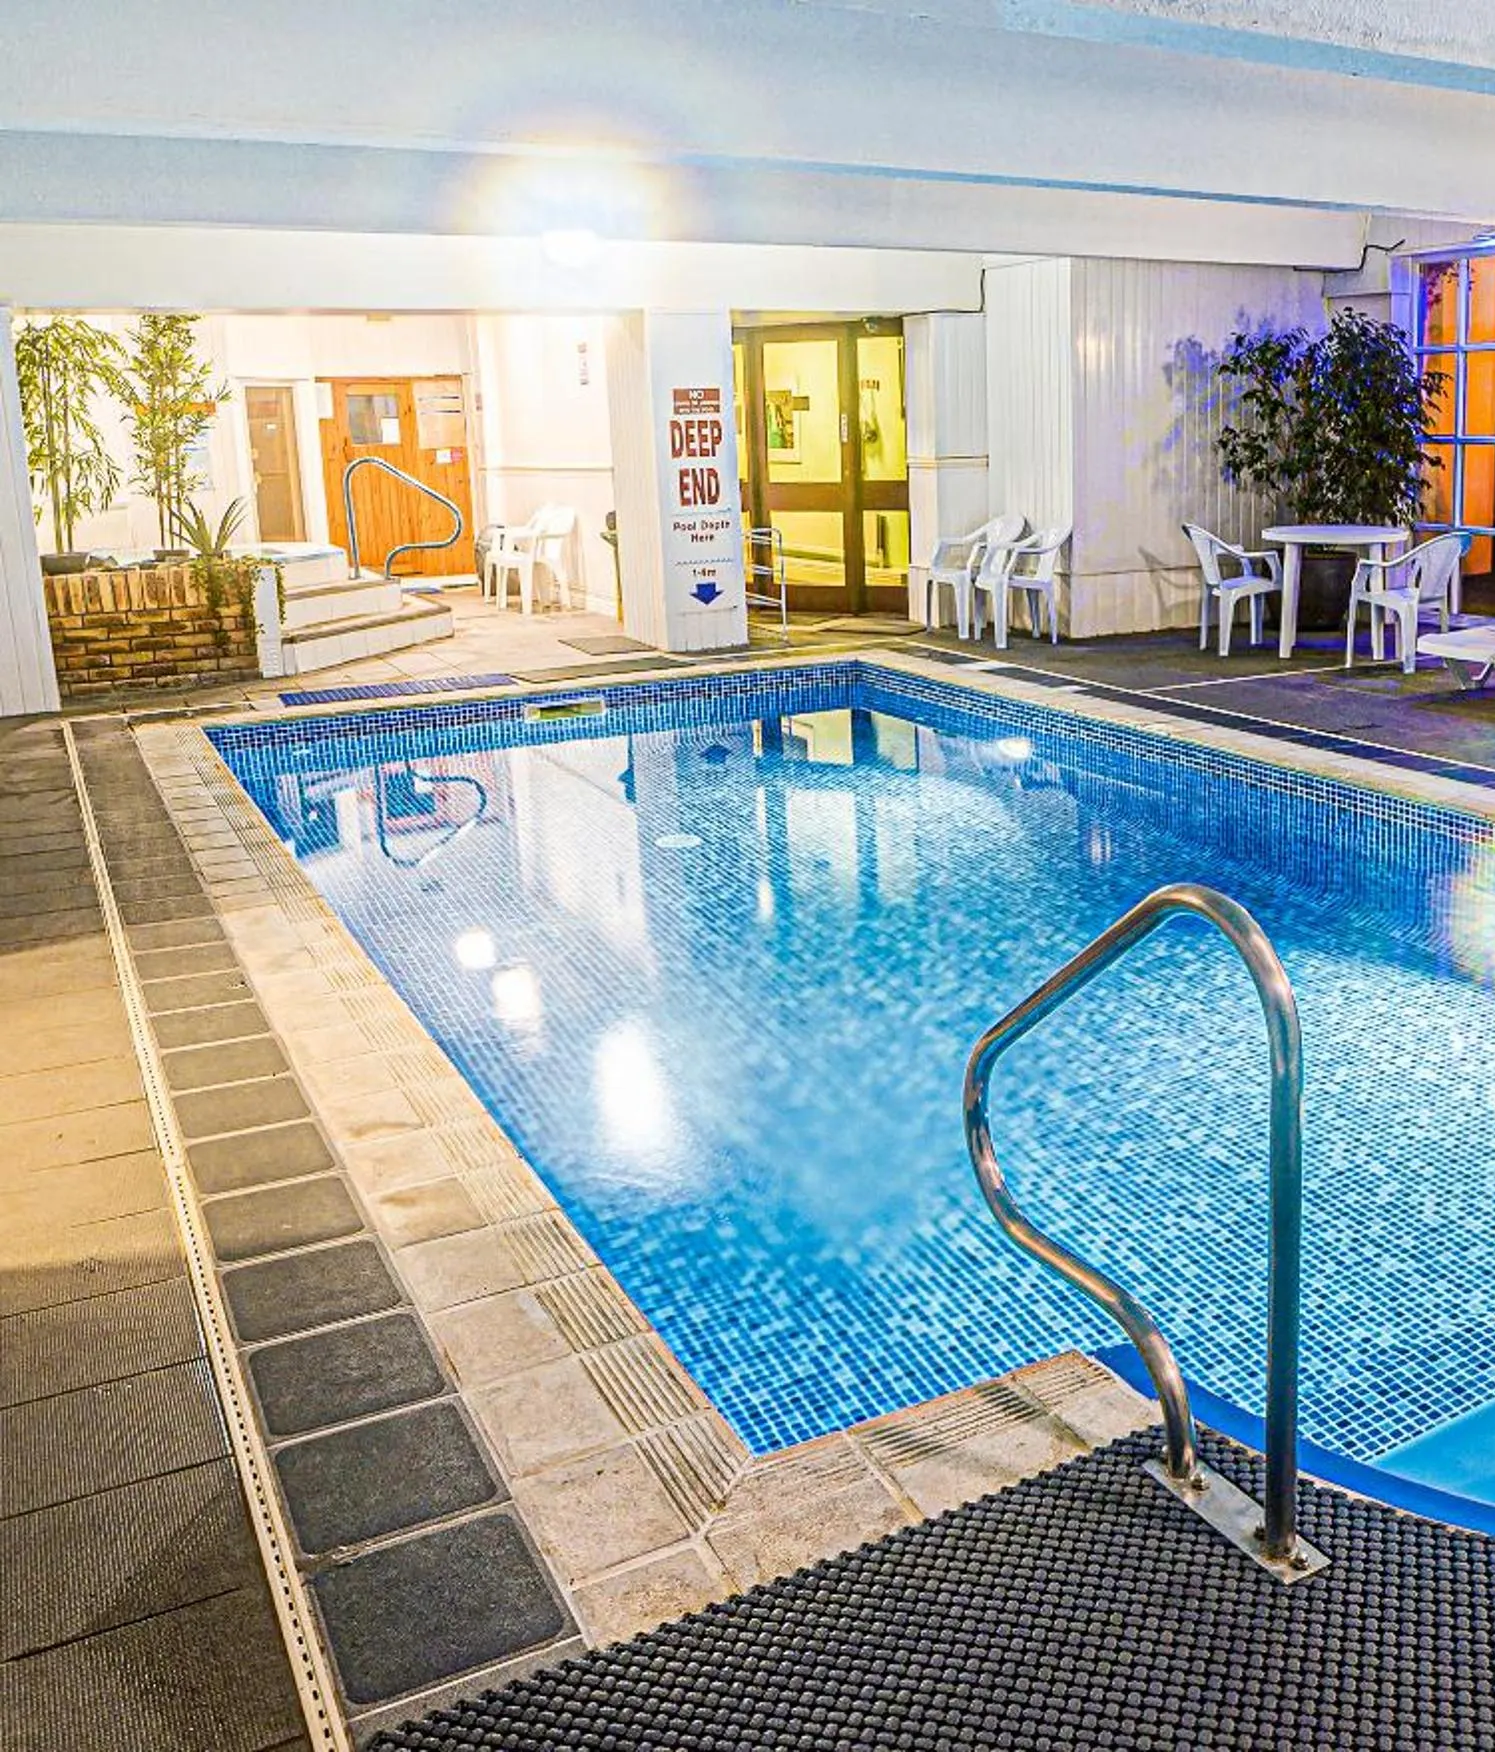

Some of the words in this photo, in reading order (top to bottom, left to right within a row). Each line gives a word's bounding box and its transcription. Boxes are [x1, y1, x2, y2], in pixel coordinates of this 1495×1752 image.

[689, 390, 704, 399] NO
[670, 420, 722, 457] DEEP
[679, 467, 720, 506] END
[673, 522, 697, 531] Pool
[691, 533, 714, 542] Here
